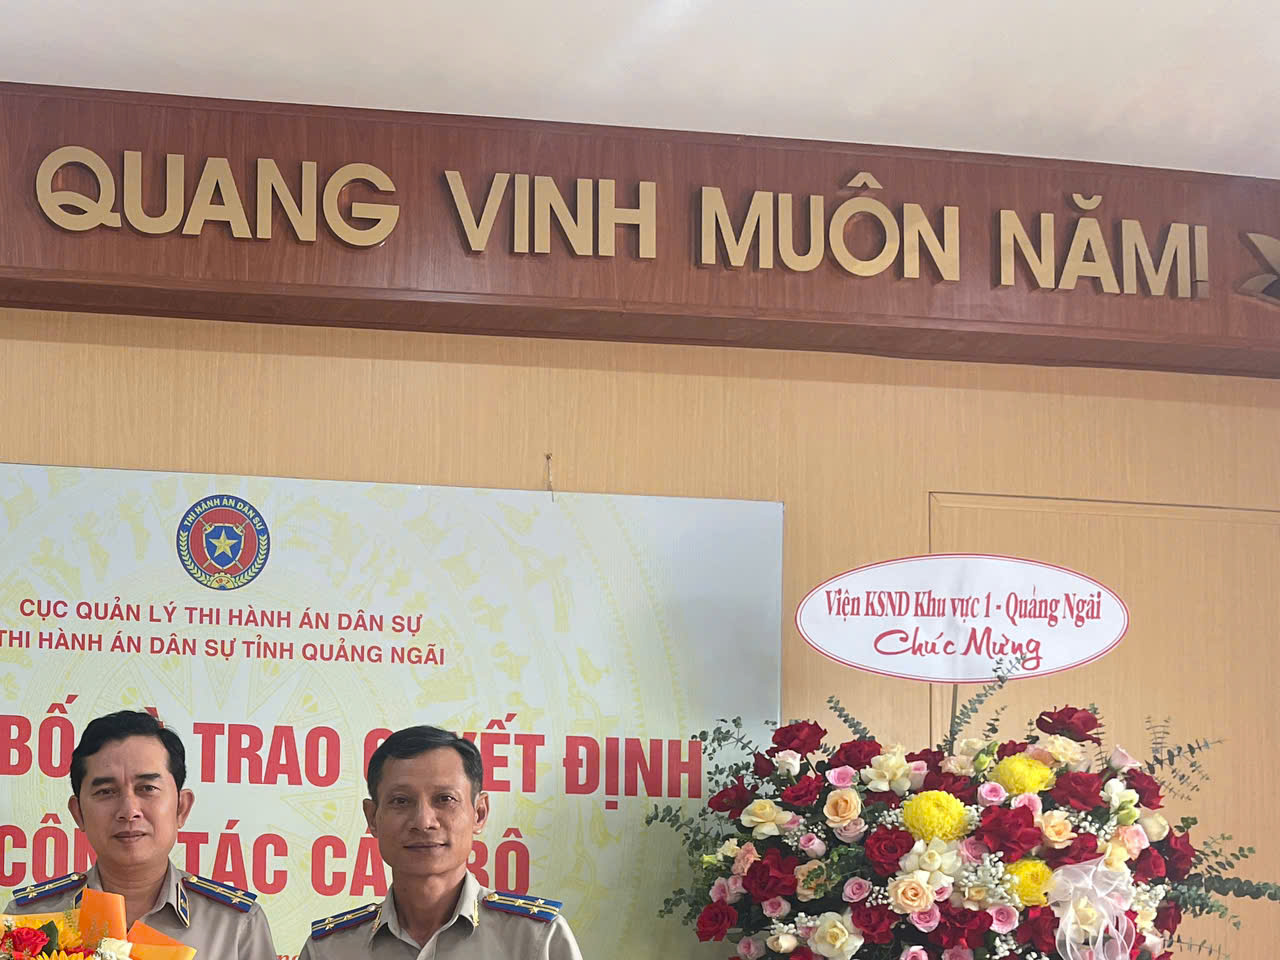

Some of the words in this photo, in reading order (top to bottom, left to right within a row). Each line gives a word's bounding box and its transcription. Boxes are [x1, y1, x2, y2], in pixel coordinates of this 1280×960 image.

[35, 145, 400, 247] QUANG
[445, 169, 657, 259] VINH
[700, 171, 960, 282] MUÔN
[1000, 193, 1210, 300] NĂM!
[20, 598, 68, 621] CỤC
[76, 596, 141, 622] QUẢN
[149, 601, 177, 623] LÝ
[184, 607, 221, 626] THI
[228, 604, 291, 628] HÀNH
[298, 607, 329, 630] ÁN
[338, 609, 384, 632] DÂN
[391, 614, 423, 637] SỰ
[825, 588, 861, 622] Viện
[864, 590, 910, 618] KSND
[914, 590, 946, 618] Khu
[950, 595, 980, 624] vực
[984, 592, 991, 618] 1
[1005, 585, 1060, 627] Quảng
[1062, 591, 1101, 628] Ngãi
[38, 628, 102, 652] HÀNH
[110, 630, 141, 653] ÁN
[150, 633, 196, 656] DÂN
[204, 637, 236, 661] SỰ
[242, 634, 294, 660] TỈNH
[301, 637, 383, 663] QUẢNG
[391, 643, 445, 665] NGÃI
[874, 627, 956, 657] Chúc
[960, 627, 1043, 671] Mừng
[193, 722, 341, 787] TRAO
[563, 735, 703, 810] ĐỊNH
[177, 819, 289, 895] TÁC
[311, 827, 389, 897] CÁ
